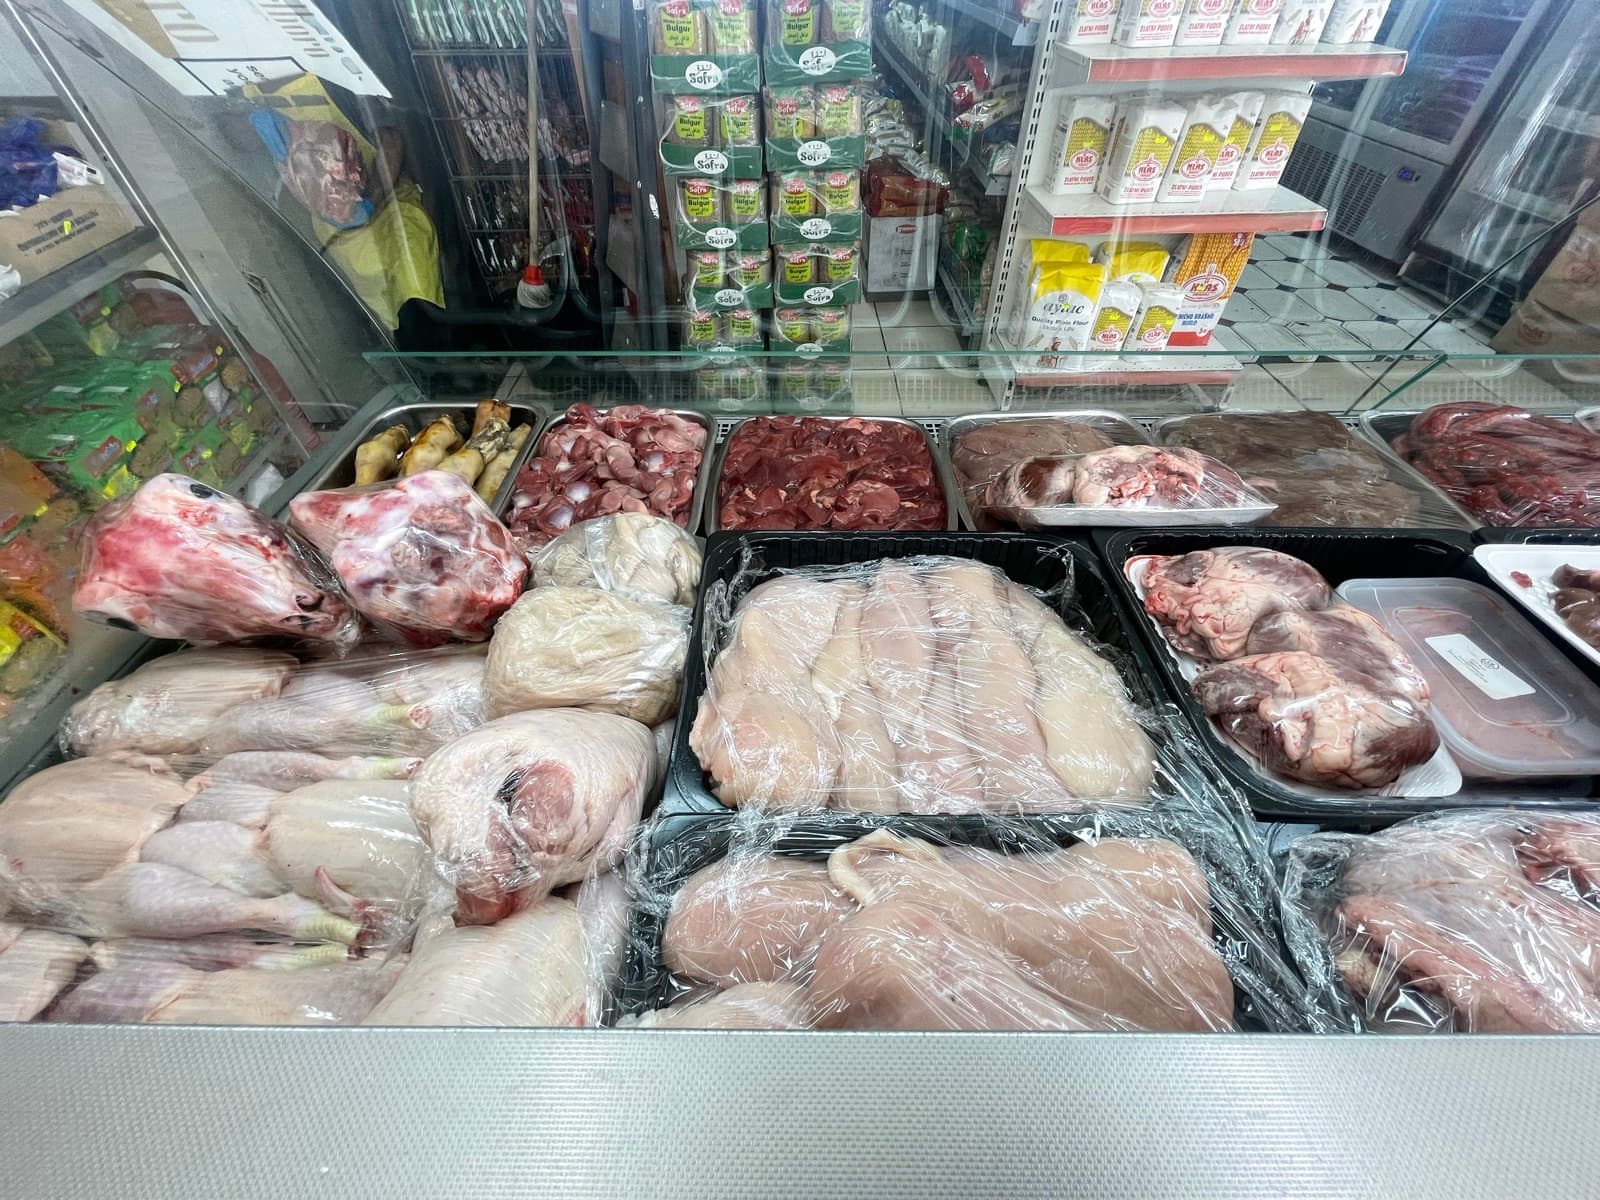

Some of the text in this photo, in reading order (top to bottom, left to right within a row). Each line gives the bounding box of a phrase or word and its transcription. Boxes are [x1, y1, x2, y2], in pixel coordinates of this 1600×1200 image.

[719, 5, 740, 14] Sofra
[786, 4, 807, 14] Sofra
[1091, 1, 1108, 9] KLAS
[1154, 2, 1171, 10] KLAS
[665, 6, 687, 15] Sofra
[666, 24, 690, 33] Bulgur
[718, 23, 742, 32] Bulgur
[786, 22, 809, 31] Bulgur
[689, 72, 719, 85] Sofra
[776, 104, 797, 113] Sofra
[679, 118, 701, 127] Bulgur
[800, 151, 828, 162] Sofra
[1265, 149, 1283, 158] KLAS
[697, 159, 726, 171] Sofra
[1186, 163, 1205, 171] KLAS
[1138, 166, 1156, 174] KLAS
[689, 185, 707, 194] Sofra
[688, 199, 710, 208] Bulgur
[708, 236, 735, 246] Sofra
[717, 295, 742, 305] Sofra
[806, 294, 831, 302] Sofra
